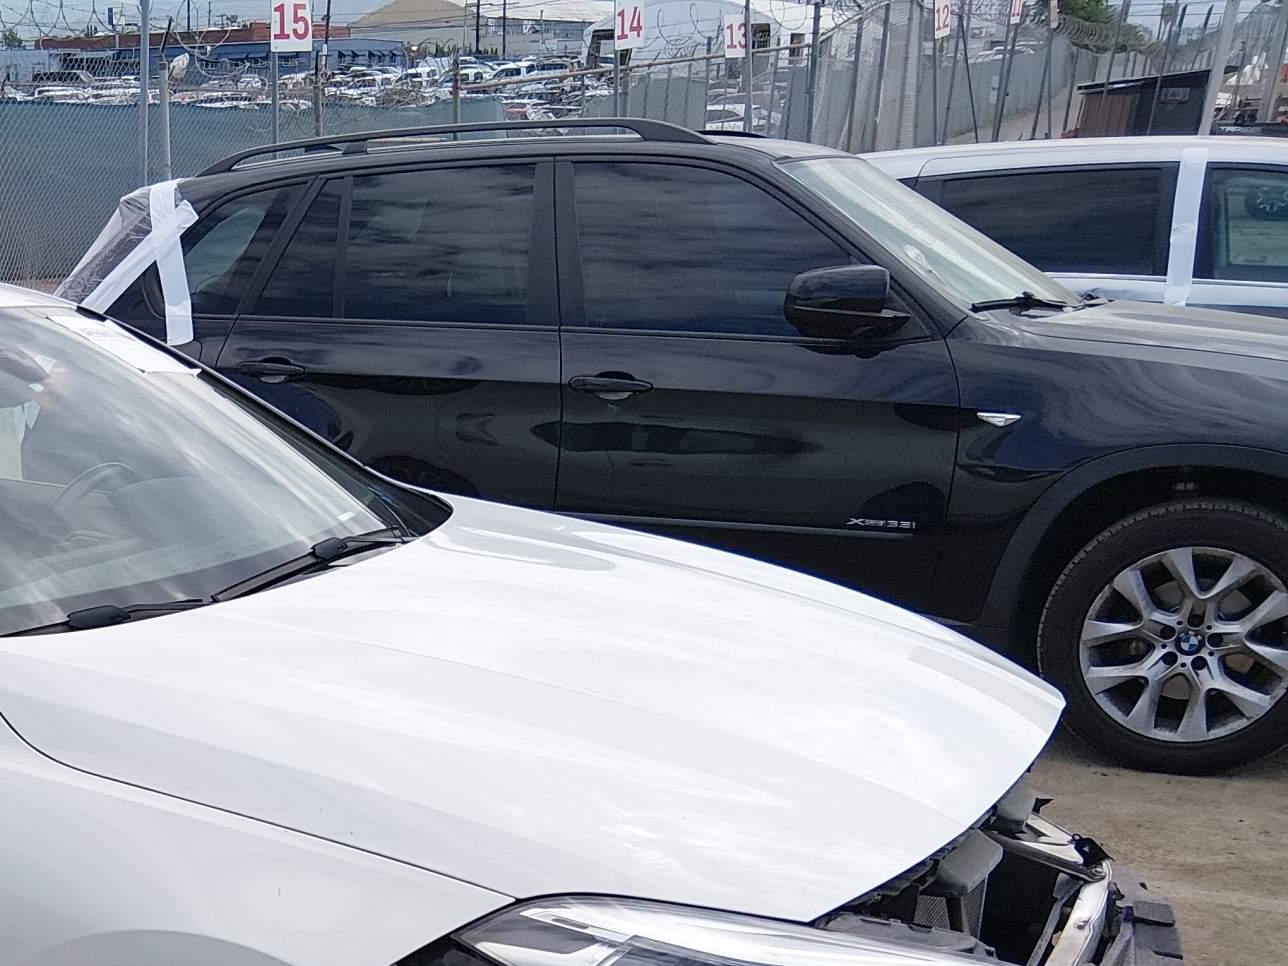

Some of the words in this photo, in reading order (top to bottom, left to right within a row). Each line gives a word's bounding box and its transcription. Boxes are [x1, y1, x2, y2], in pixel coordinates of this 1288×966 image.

[273, 3, 310, 40] 15
[616, 6, 643, 40] 14
[935, 4, 950, 31] 12
[726, 22, 747, 49] 13
